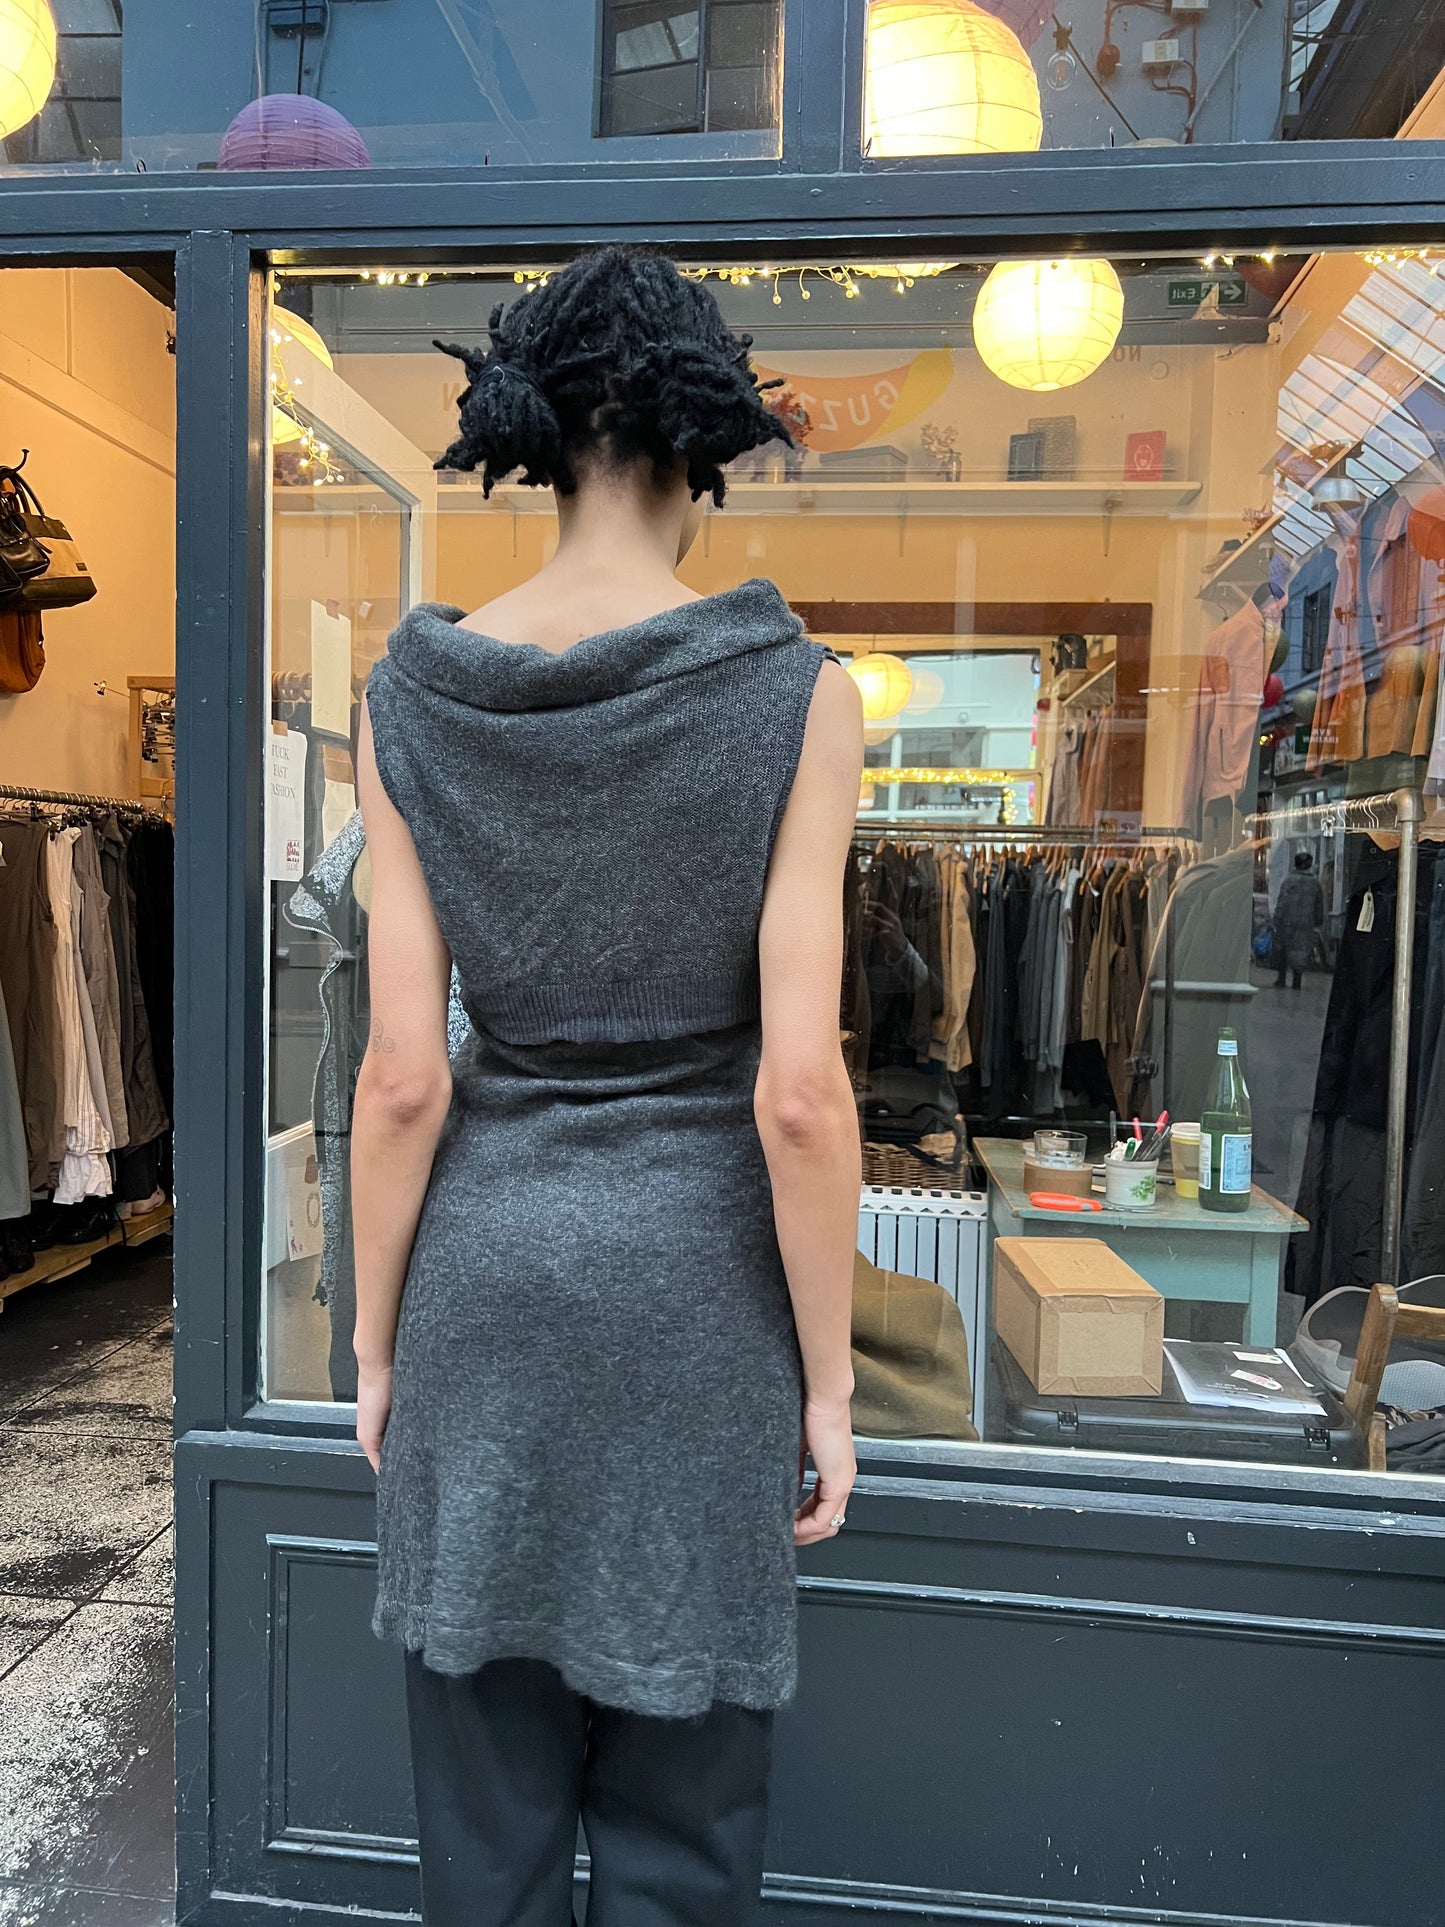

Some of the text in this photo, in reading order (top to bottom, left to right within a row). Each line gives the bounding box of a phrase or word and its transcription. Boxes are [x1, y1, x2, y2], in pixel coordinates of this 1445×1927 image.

[271, 743, 290, 761] FUCK
[273, 764, 289, 780] FAST
[270, 781, 297, 800] ASHION
